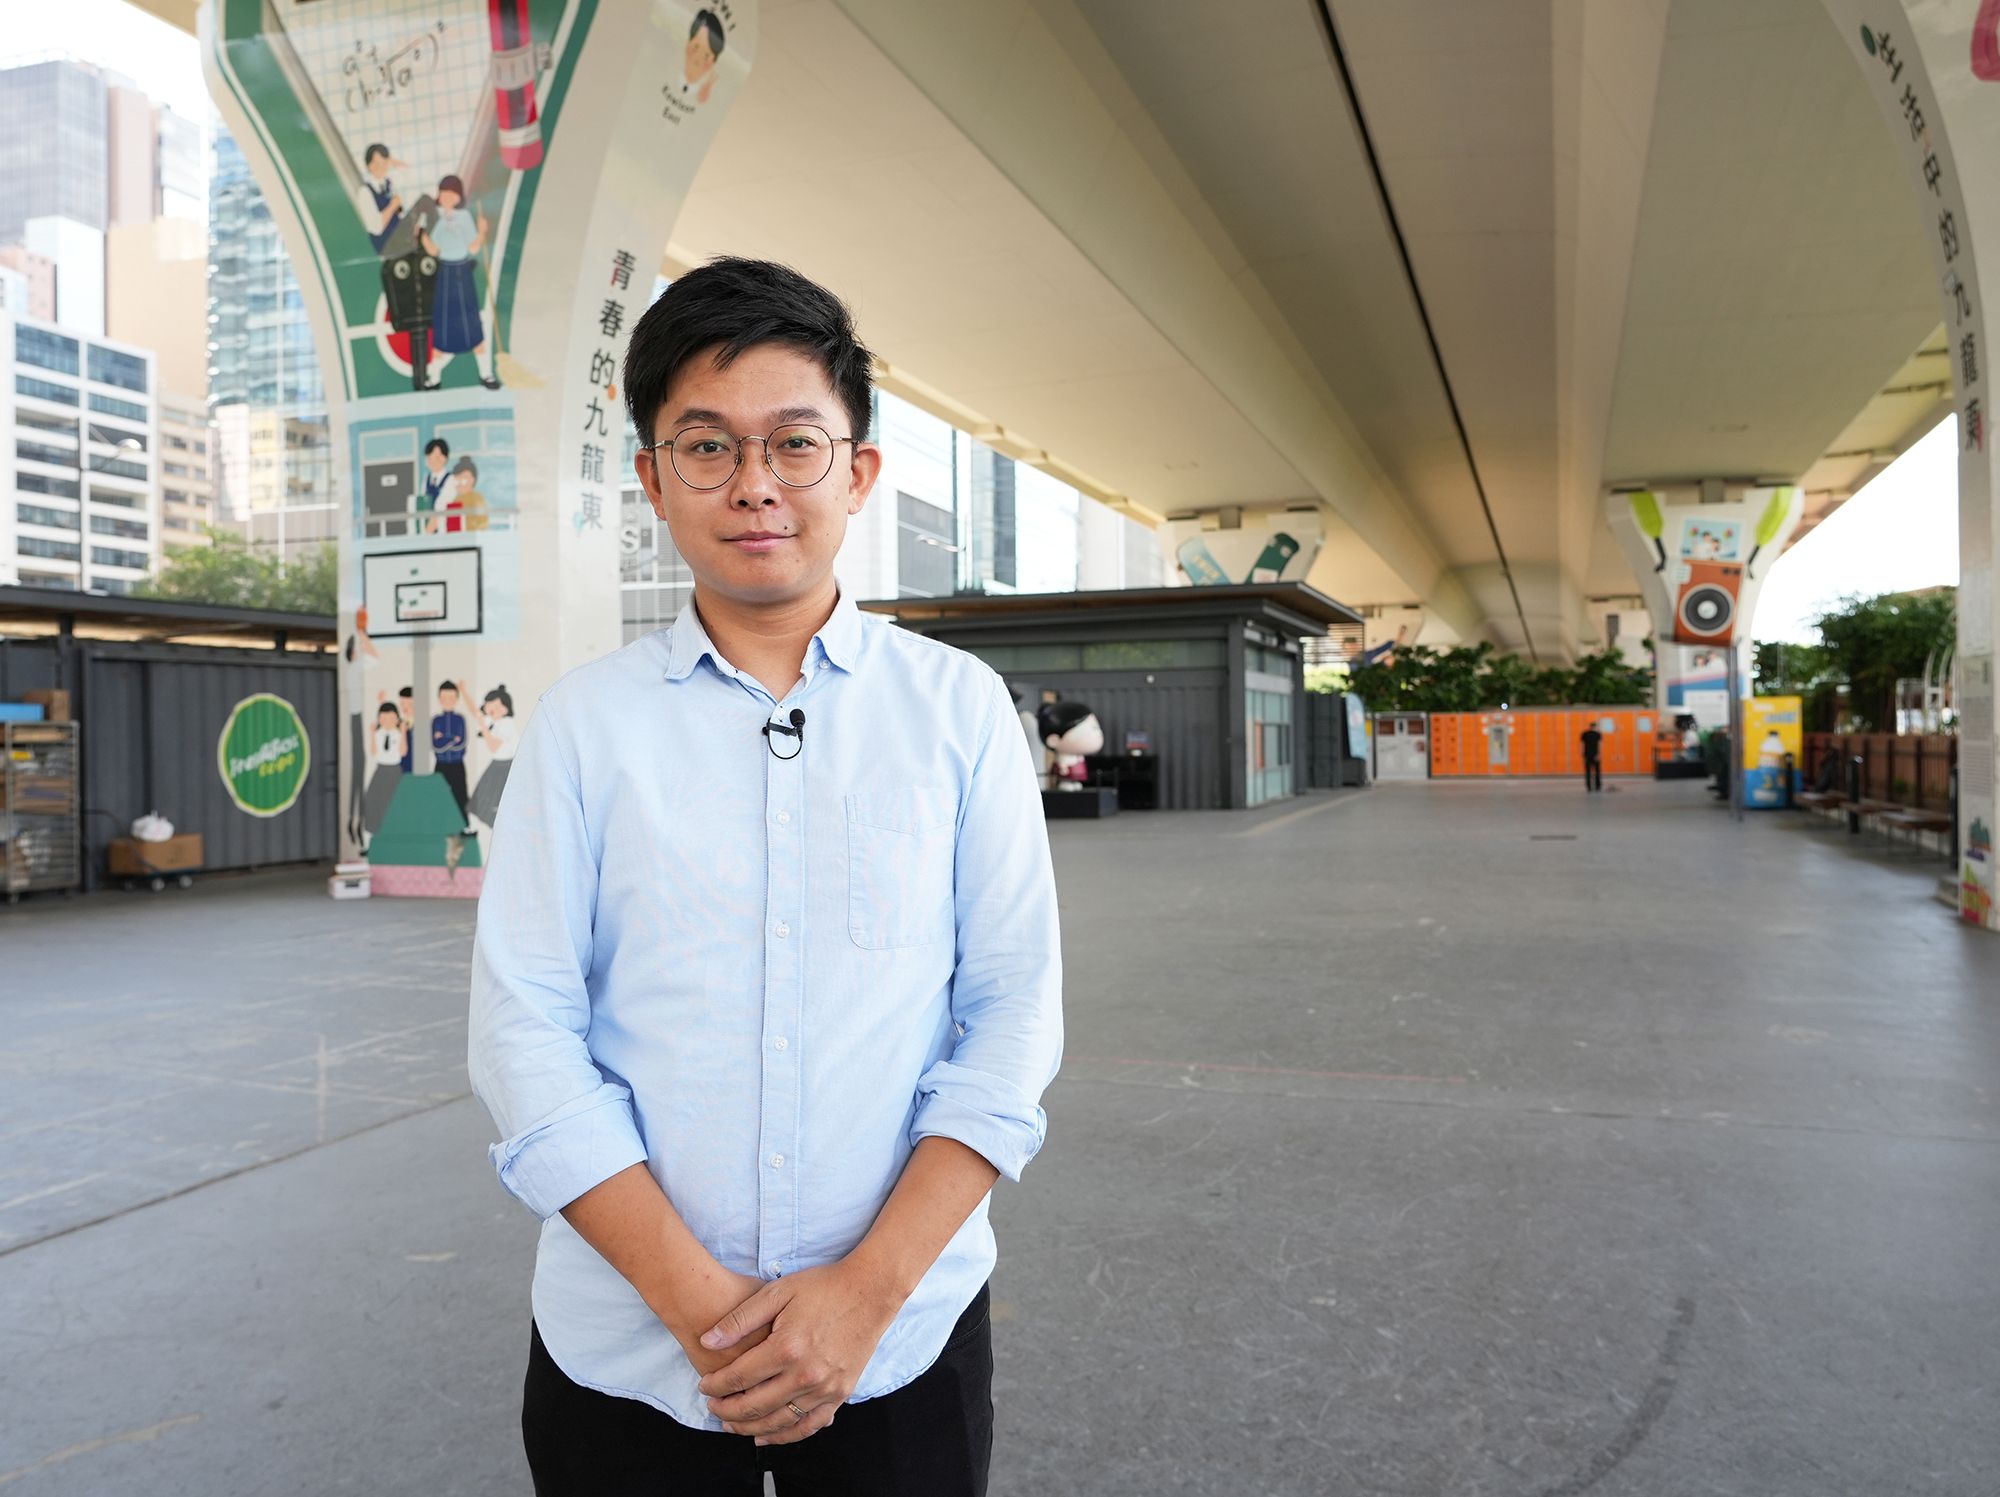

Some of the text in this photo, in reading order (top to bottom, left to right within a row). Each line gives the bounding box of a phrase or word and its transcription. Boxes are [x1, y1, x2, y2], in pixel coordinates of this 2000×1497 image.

[580, 249, 636, 530] 青春的九龍東
